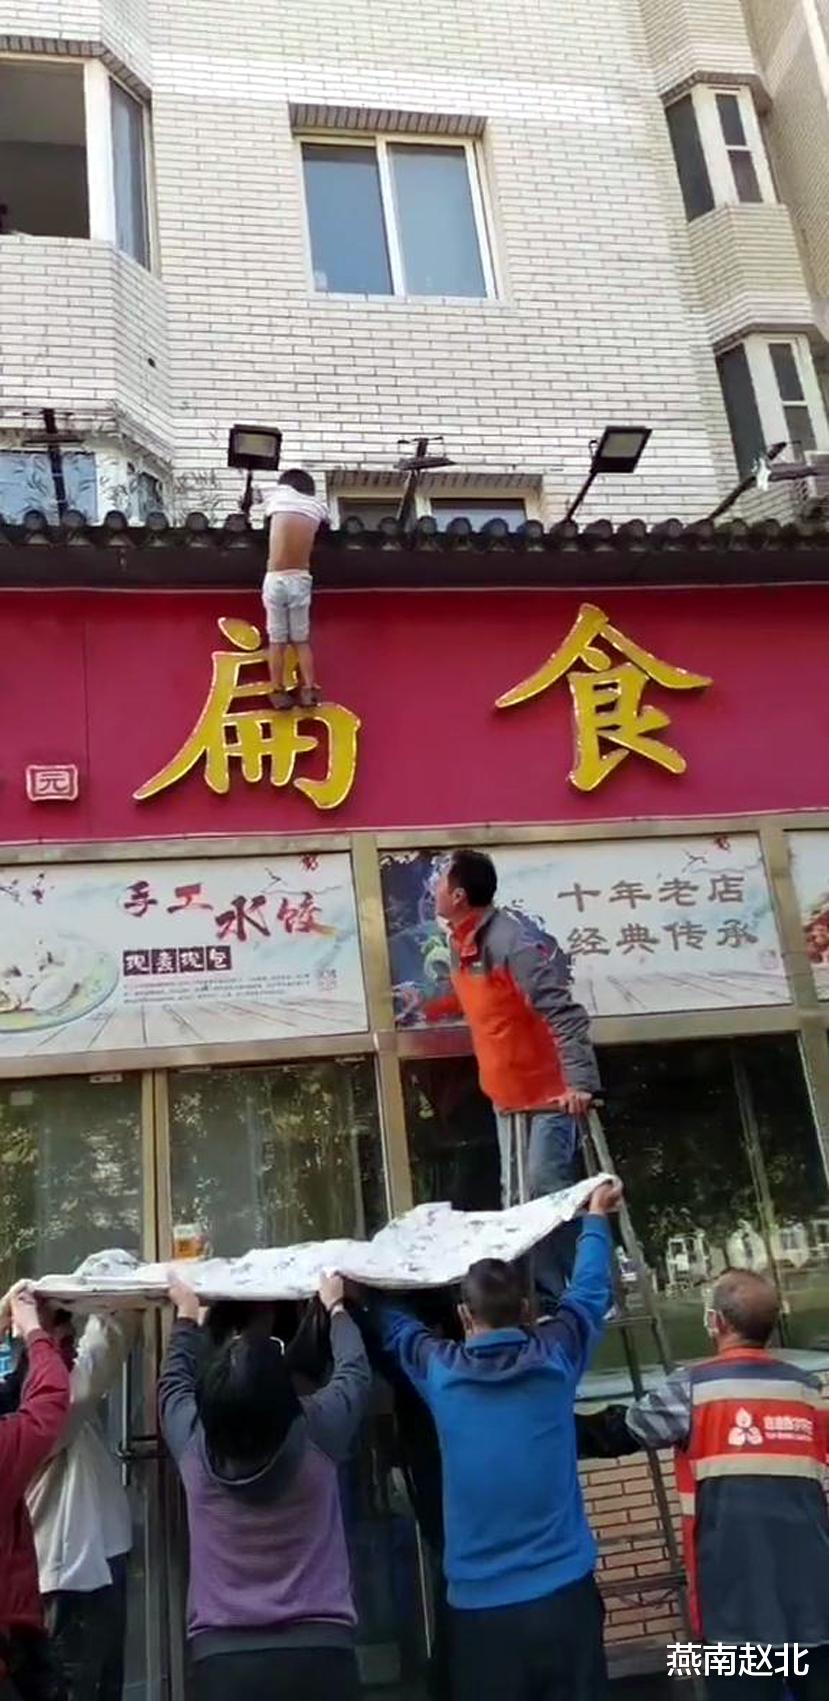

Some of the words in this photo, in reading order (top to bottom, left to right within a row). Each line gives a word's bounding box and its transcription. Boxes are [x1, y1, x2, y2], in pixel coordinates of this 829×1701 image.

[133, 603, 713, 809] 扁食
[557, 873, 745, 912] 十年老店
[567, 918, 758, 957] 经典传承
